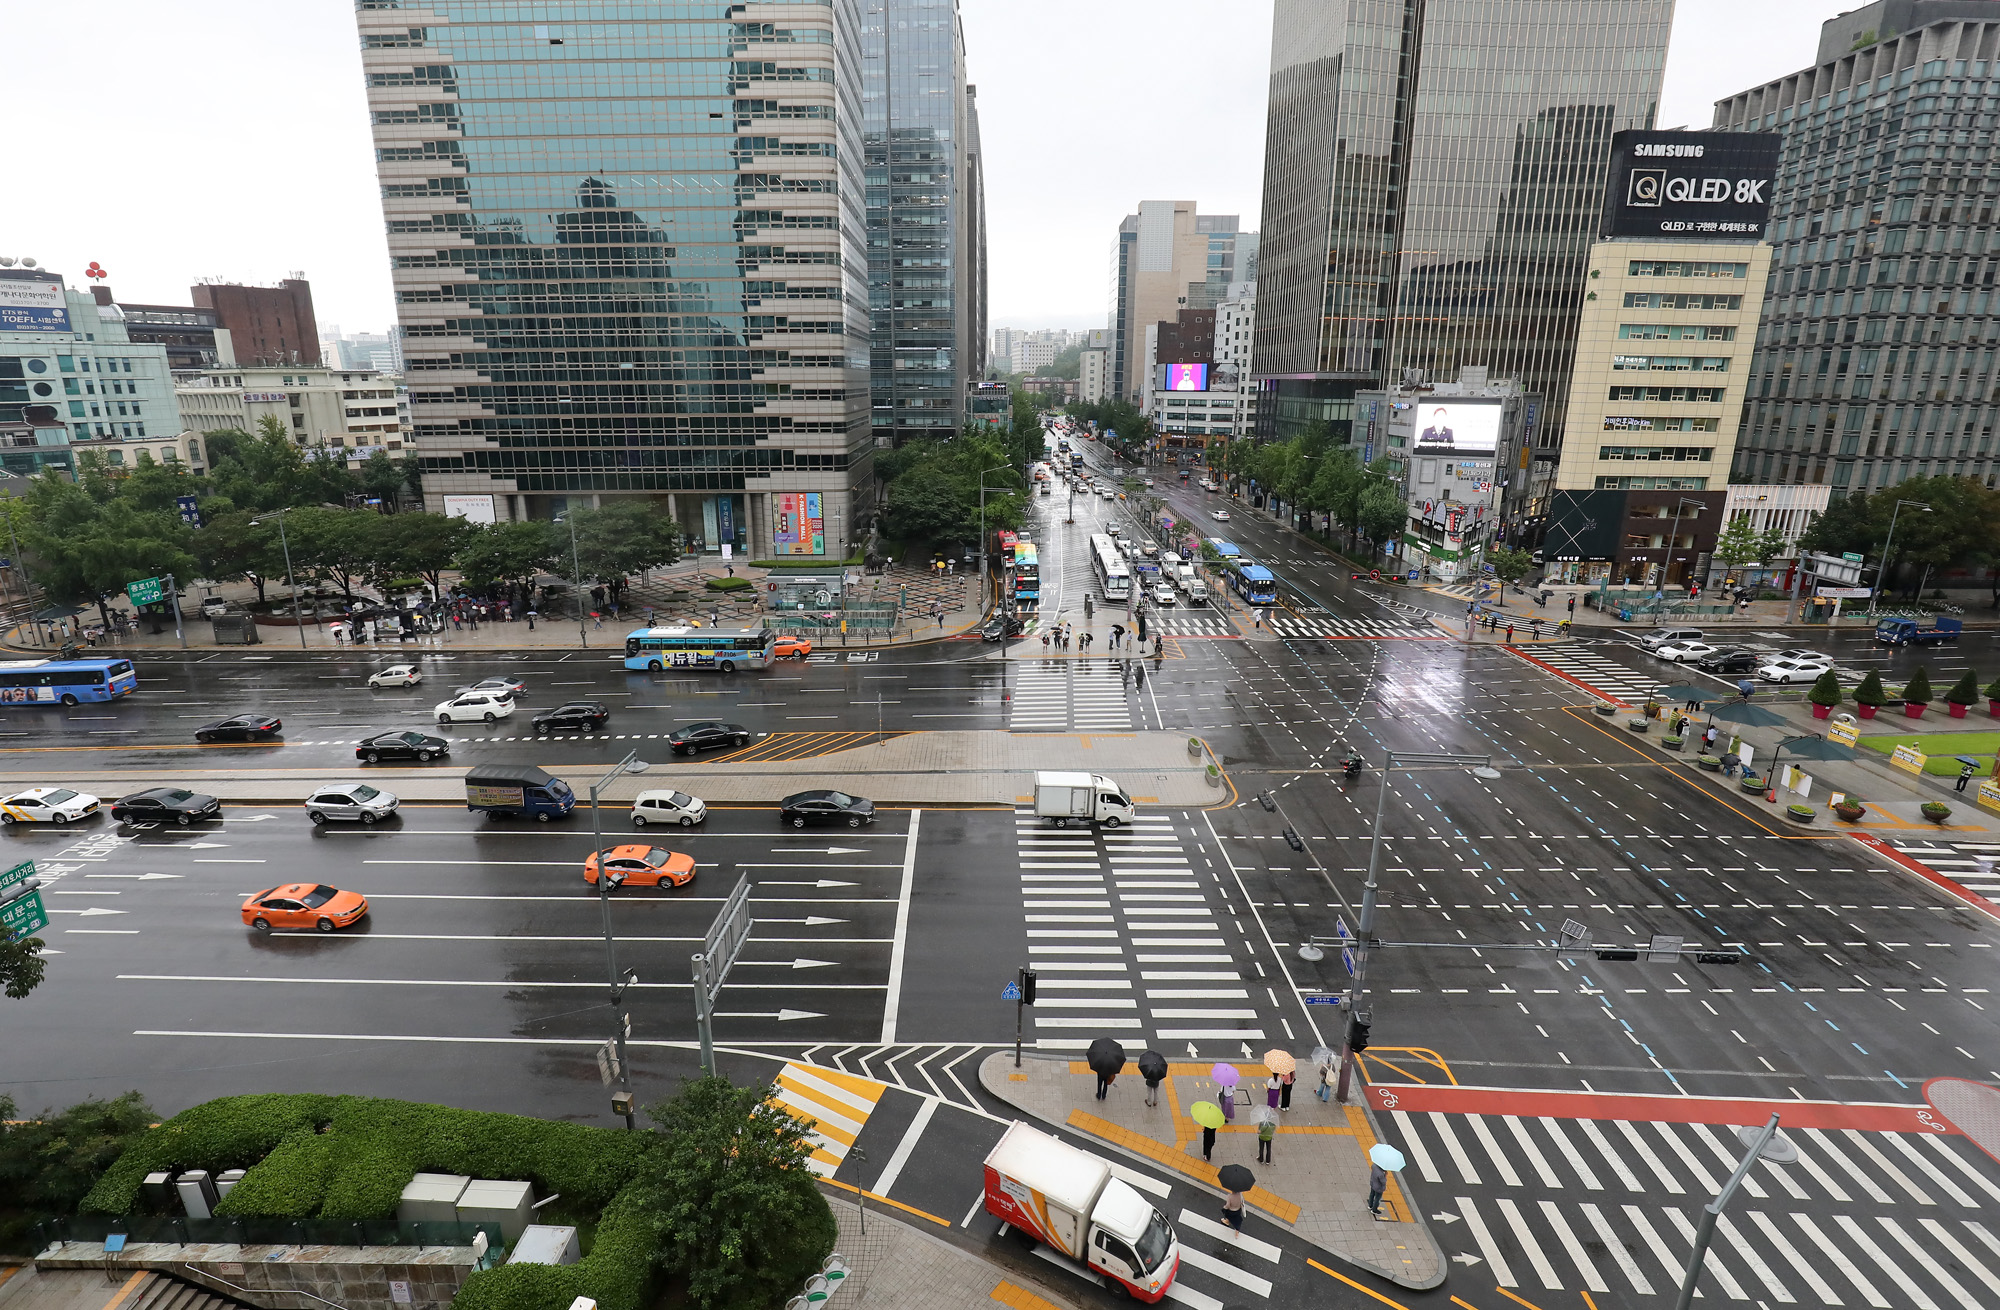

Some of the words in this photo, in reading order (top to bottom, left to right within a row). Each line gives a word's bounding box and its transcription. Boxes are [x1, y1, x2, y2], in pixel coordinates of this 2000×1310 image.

[1634, 144, 1704, 157] SAMSUNG
[1636, 176, 1657, 199] Q
[1666, 178, 1731, 203] QLED
[1734, 179, 1768, 204] 8K
[1661, 222, 1685, 231] QLED
[1748, 224, 1759, 232] 8K
[2, 315, 37, 323] TOEFL
[1479, 481, 1492, 493] 약
[130, 580, 158, 593] 종로1가
[663, 651, 698, 665] 에듀윌
